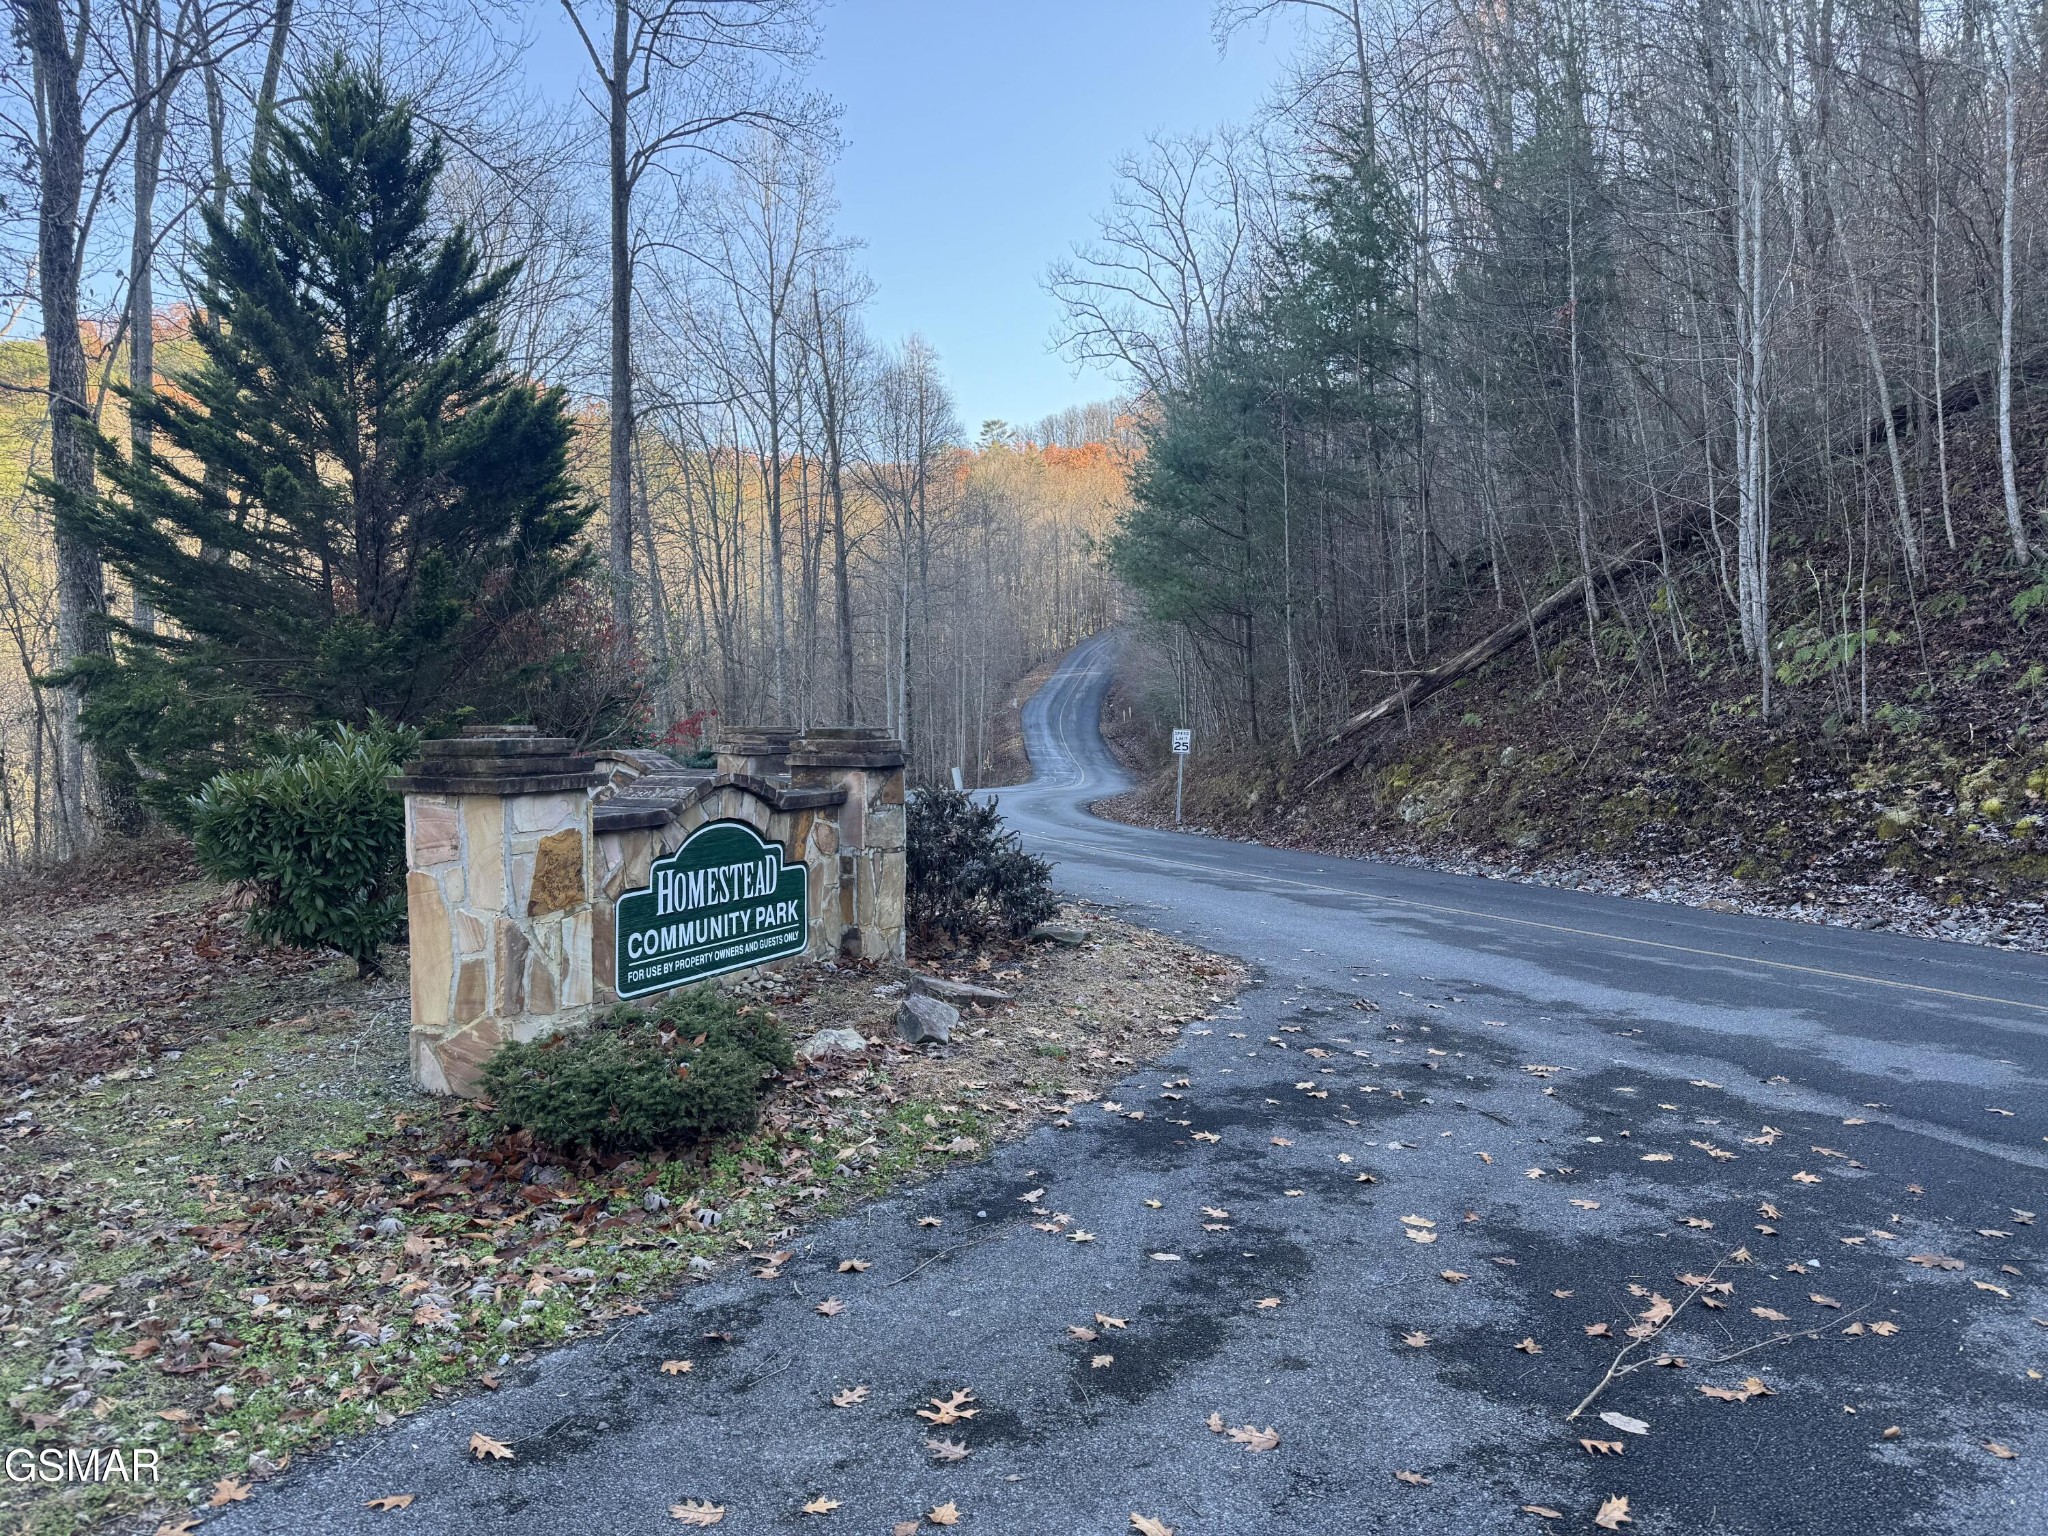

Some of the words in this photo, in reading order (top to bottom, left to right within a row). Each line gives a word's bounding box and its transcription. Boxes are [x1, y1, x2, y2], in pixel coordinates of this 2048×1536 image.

[1174, 741, 1189, 751] 25
[656, 854, 778, 916] HOMESTEAD
[627, 908, 751, 959] COMMUNITY
[755, 899, 799, 930] PARK
[627, 969, 645, 983] FOR
[646, 965, 662, 978] USE
[663, 961, 675, 974] BY
[675, 953, 714, 971] PROPERTY
[714, 946, 744, 961] OWNERS
[744, 942, 759, 955] AND
[759, 936, 784, 951] GUESTS
[783, 930, 800, 944] ONLY
